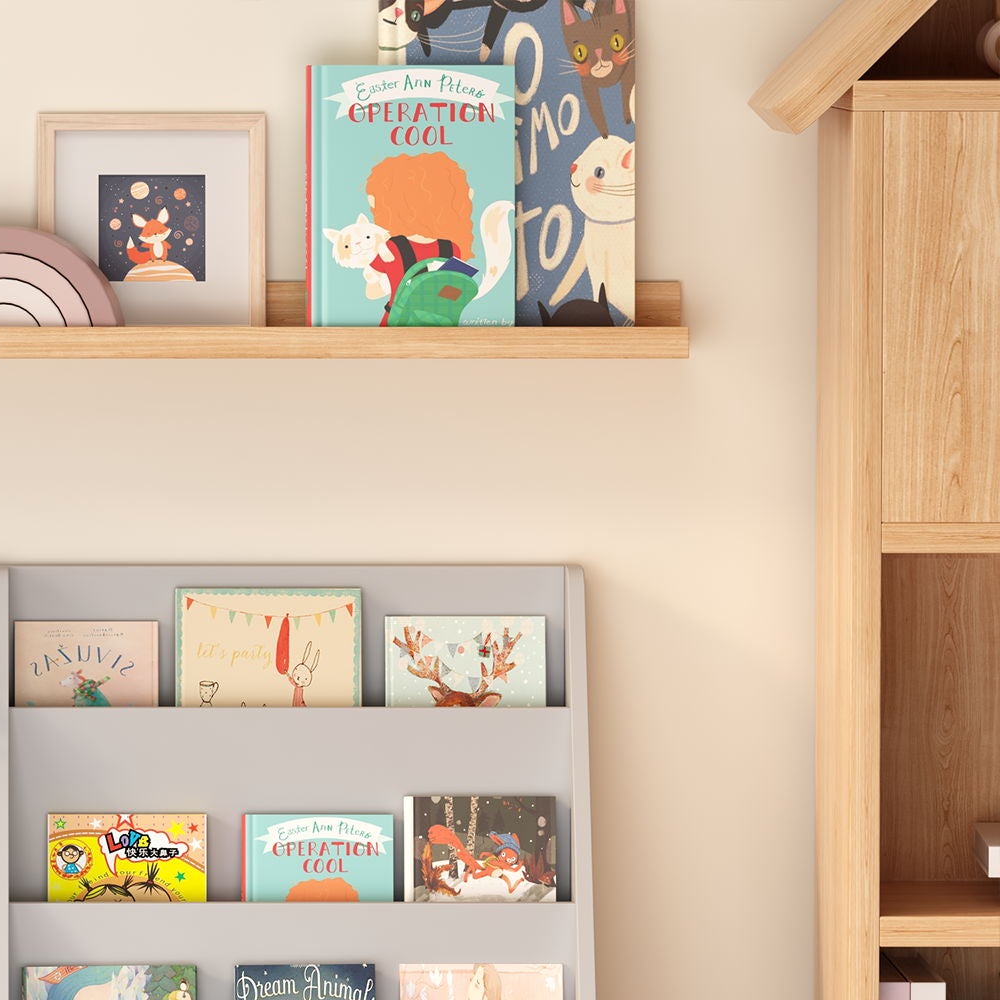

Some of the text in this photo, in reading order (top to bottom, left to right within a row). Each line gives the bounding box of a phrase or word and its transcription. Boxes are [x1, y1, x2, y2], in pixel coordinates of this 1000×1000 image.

[348, 102, 495, 123] OPERATION
[390, 125, 453, 146] COOL
[230, 643, 273, 670] party
[125, 847, 180, 859] 快乐大鼻子
[272, 841, 379, 857] OPERATION
[302, 858, 349, 874] COOL
